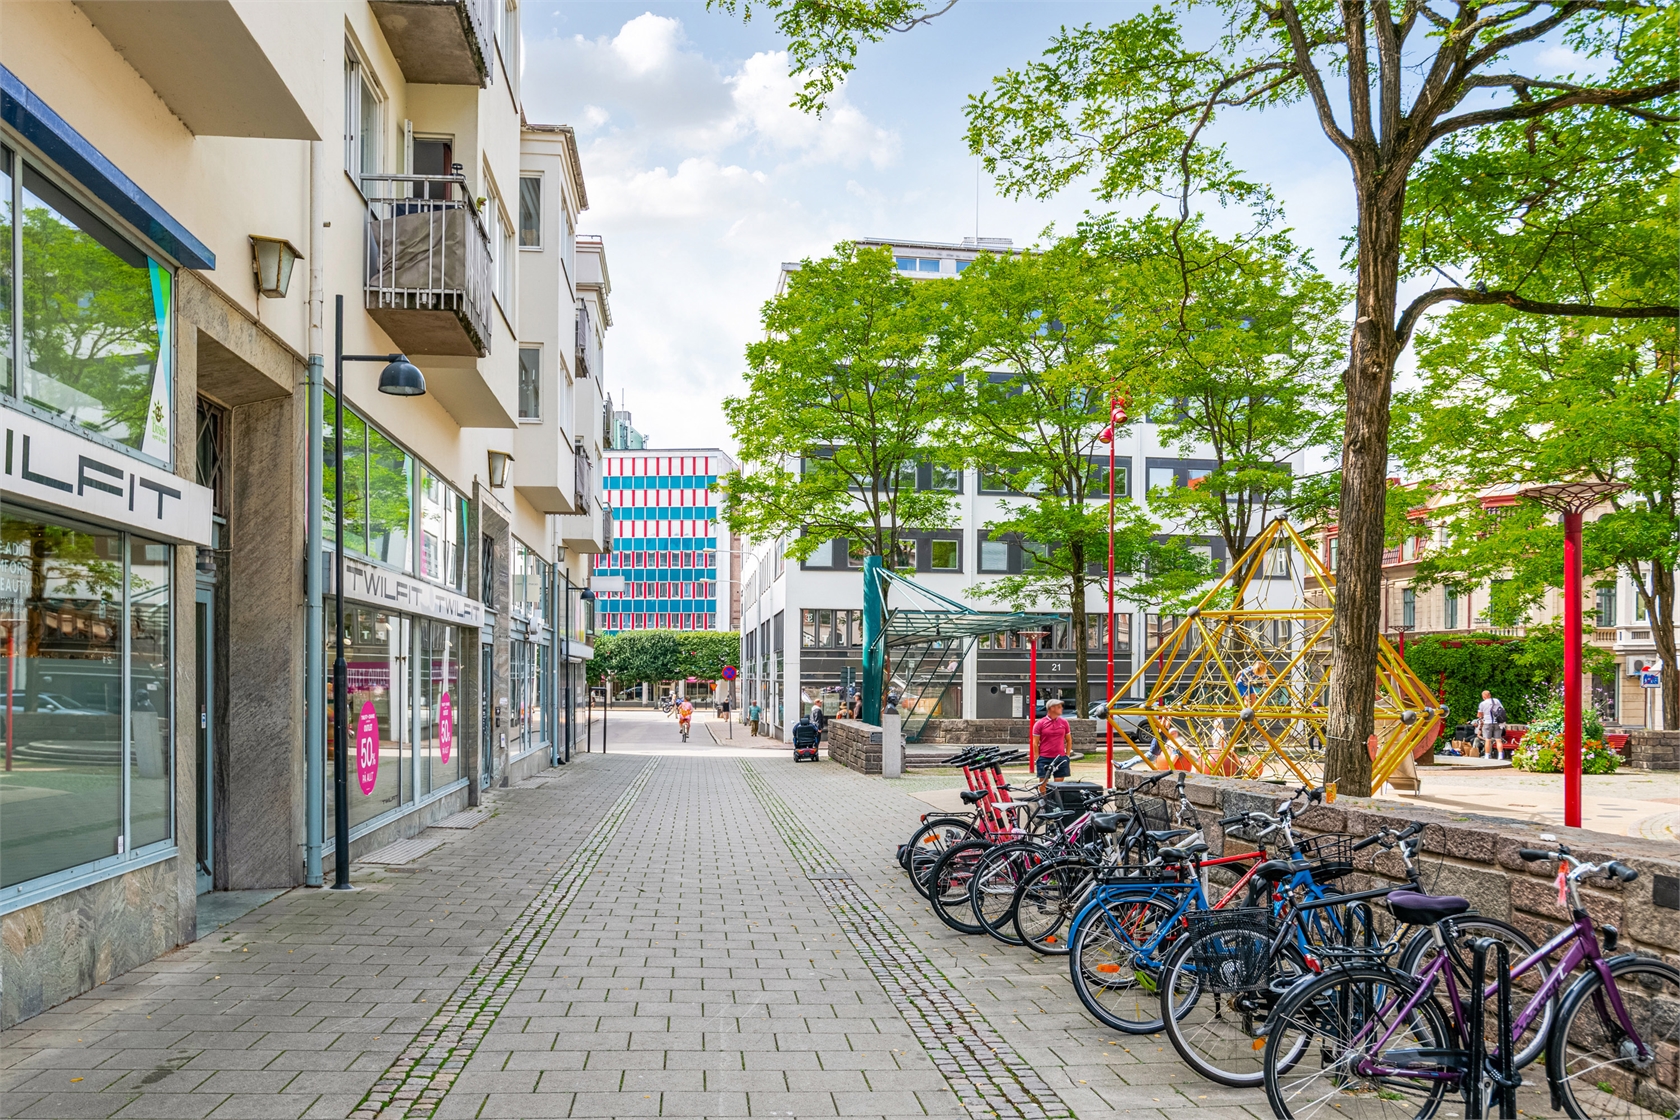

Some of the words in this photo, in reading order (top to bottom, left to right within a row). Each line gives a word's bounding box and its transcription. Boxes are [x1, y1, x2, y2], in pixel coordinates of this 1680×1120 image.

[5, 428, 181, 519] ILFIT
[5, 542, 24, 557] ADD
[346, 565, 423, 606] TWILFIT
[435, 595, 480, 621] TWILFIT
[1051, 663, 1061, 672] 21
[361, 736, 376, 769] 50%
